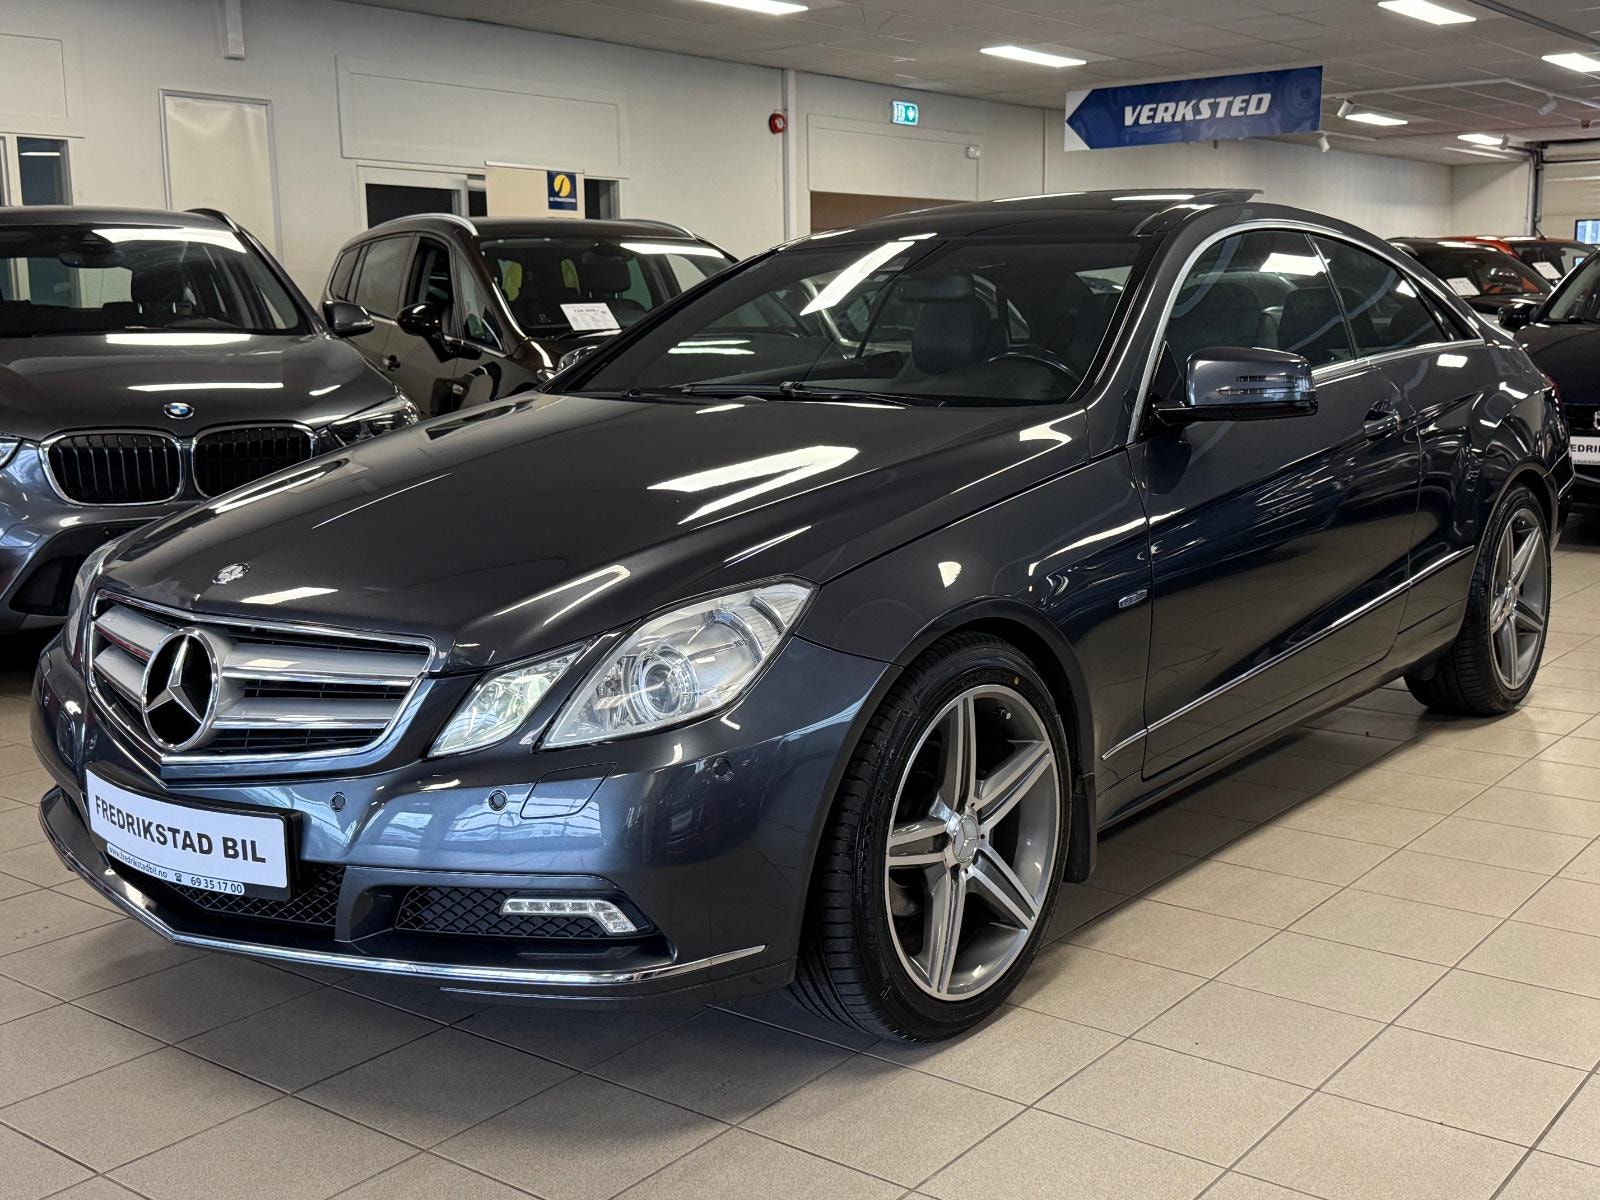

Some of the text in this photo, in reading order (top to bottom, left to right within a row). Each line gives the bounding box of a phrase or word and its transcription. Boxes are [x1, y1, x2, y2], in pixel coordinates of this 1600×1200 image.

[1124, 93, 1271, 126] VERKSTED
[1570, 444, 1600, 454] EDRI
[95, 794, 266, 863] FREDRIKSTAD BIL
[109, 845, 243, 894] www.fredrikstadbil.no 69 35 17 00
